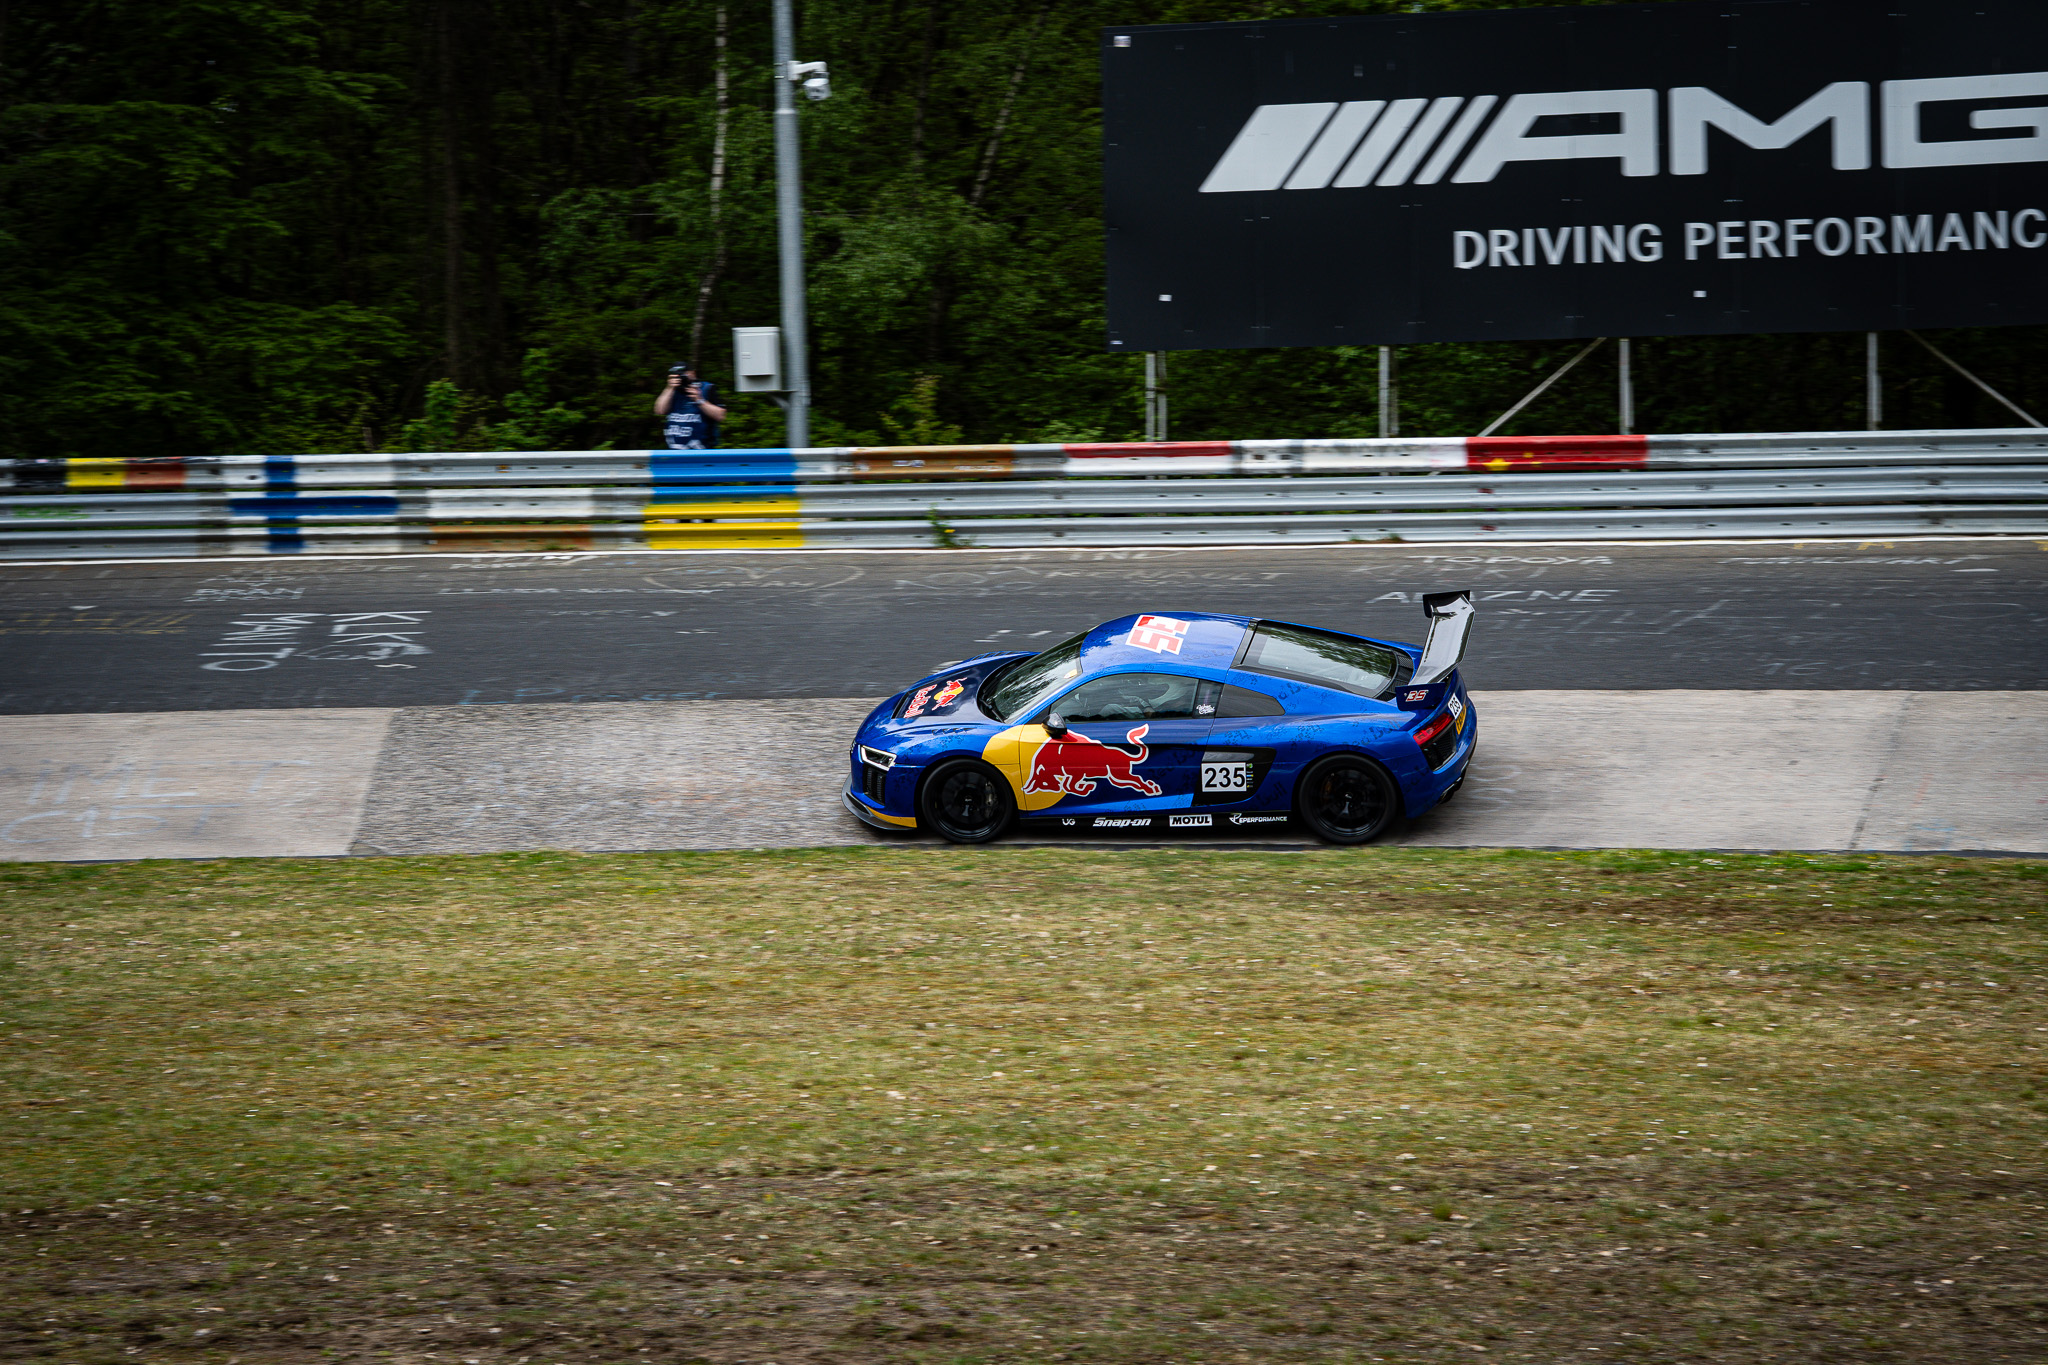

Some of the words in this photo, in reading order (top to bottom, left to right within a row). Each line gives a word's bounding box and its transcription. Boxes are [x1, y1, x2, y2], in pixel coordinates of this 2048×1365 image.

[1450, 72, 2048, 184] AMG
[1452, 222, 1663, 269] DRIVING
[1364, 589, 1621, 604] ALZNE
[1405, 690, 1429, 702] 35
[1204, 766, 1246, 788] 235
[1092, 816, 1152, 828] Snap-on
[1172, 815, 1210, 825] MOTUL
